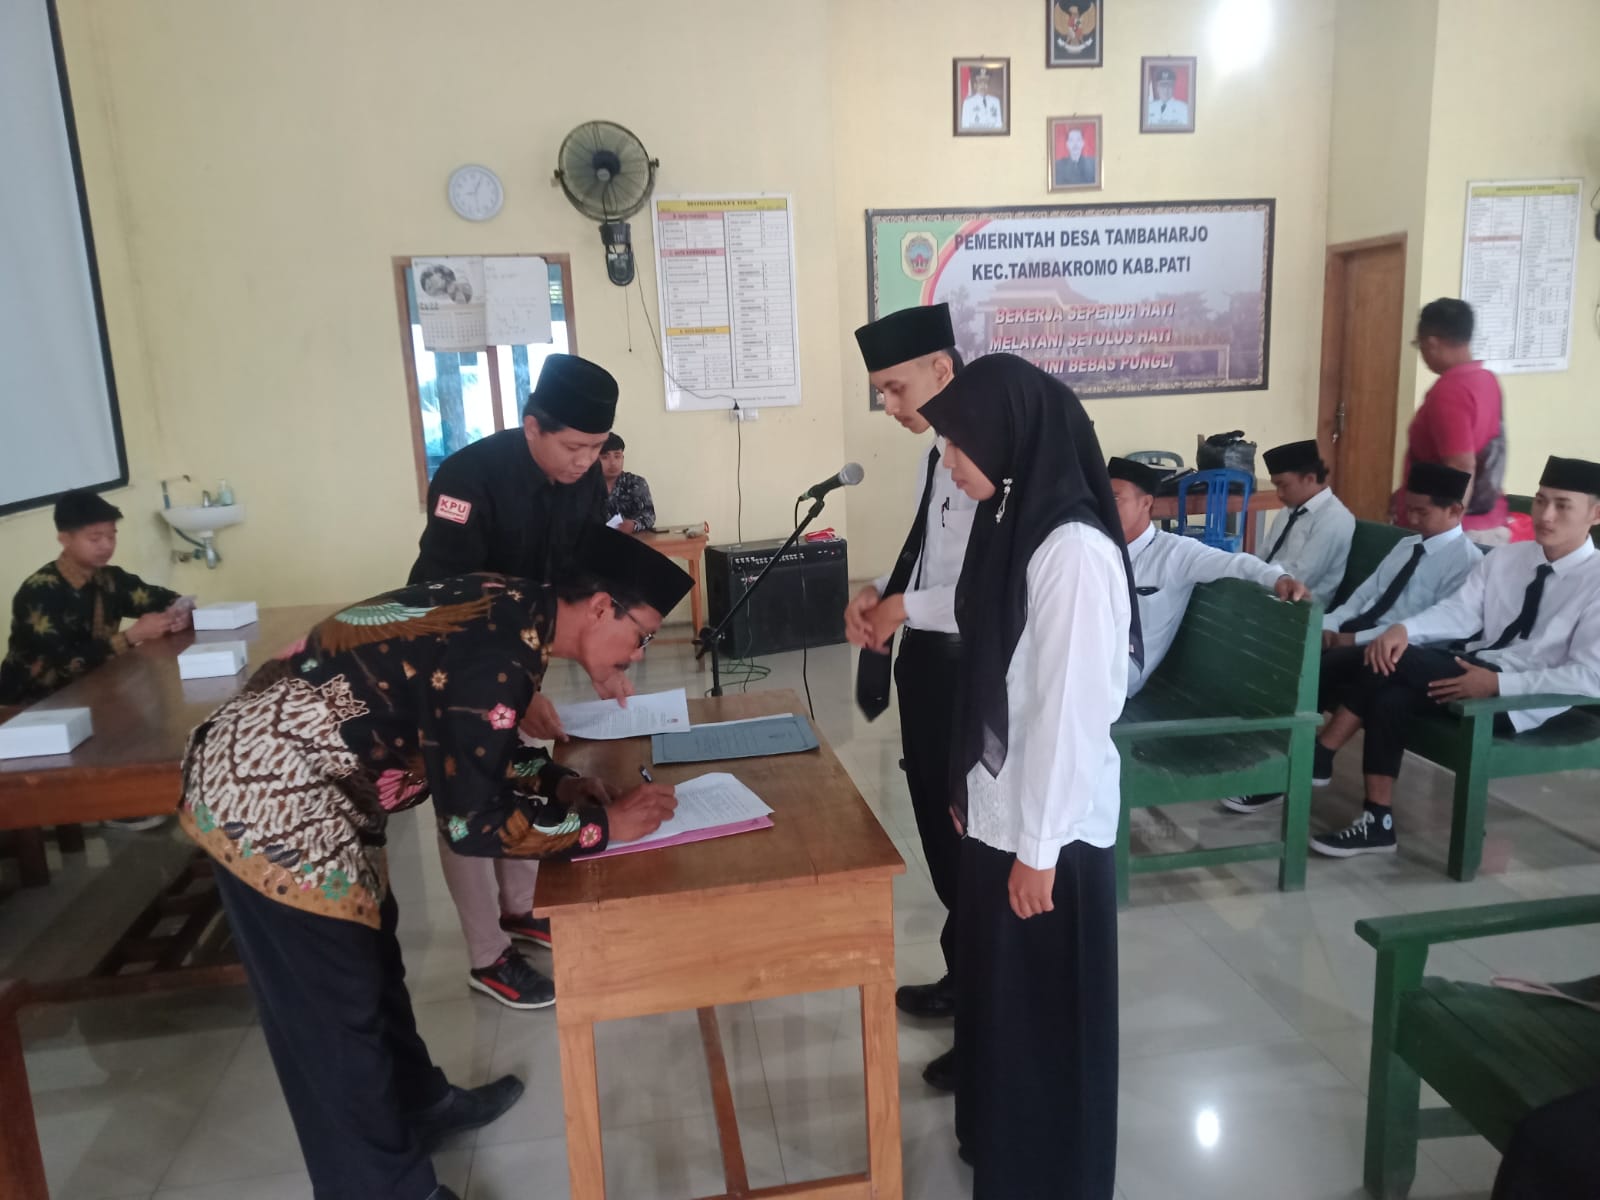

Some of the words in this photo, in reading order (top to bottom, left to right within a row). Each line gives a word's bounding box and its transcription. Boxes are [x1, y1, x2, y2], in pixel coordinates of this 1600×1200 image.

[954, 231, 1055, 250] PEMERINTAH
[1060, 229, 1100, 247] DESA
[1105, 226, 1208, 246] TAMBAHARJO
[972, 259, 1118, 281] KEC.TAMBAKROMO
[1122, 256, 1190, 275] KAB.PATI
[995, 307, 1063, 325] BEKERJA
[1067, 304, 1137, 321] SEPENUH
[1140, 302, 1175, 317] HATI
[990, 334, 1064, 351] MELAYANI
[1067, 331, 1134, 347] SETULUS
[1138, 328, 1172, 343] HATI
[1068, 357, 1116, 373] BEBAS
[1120, 354, 1175, 371] PUNGLI
[440, 499, 466, 513] KPU
